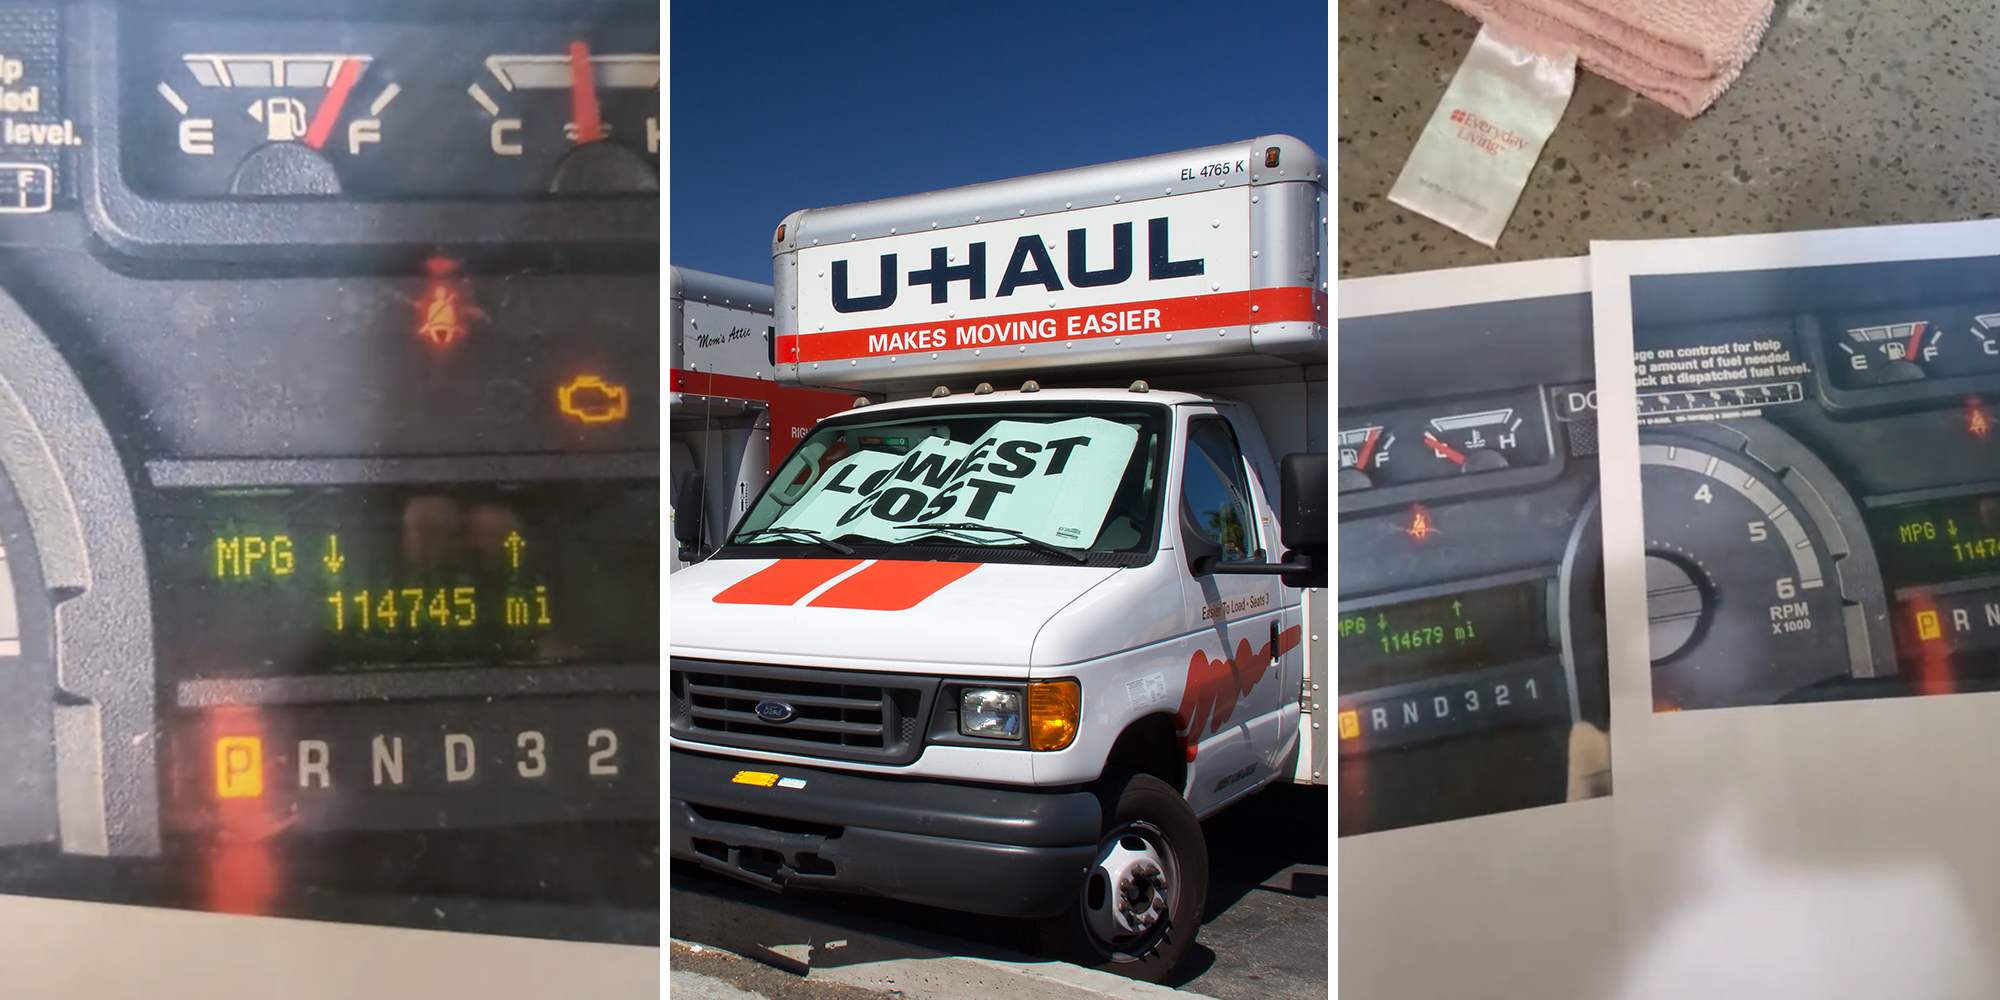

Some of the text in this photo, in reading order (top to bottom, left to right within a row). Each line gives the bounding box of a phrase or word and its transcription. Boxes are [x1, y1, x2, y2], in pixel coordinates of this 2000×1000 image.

[5, 118, 82, 145] level.
[179, 118, 382, 155] E F
[490, 118, 522, 155] C
[1457, 127, 1500, 155] Living
[1463, 113, 1528, 150] Everyday
[17, 170, 35, 183] F
[1181, 160, 1244, 181] EL 4765 K
[831, 216, 1205, 314] U-HAUL
[697, 326, 752, 348] Mom's Attic
[868, 308, 1161, 353] MAKES MOVING EASIER
[1657, 349, 1675, 359] on
[1677, 343, 1730, 357] contract
[1732, 341, 1752, 353] for
[1753, 339, 1782, 352] help
[1851, 346, 1939, 370] E F
[1983, 339, 1999, 355] C
[1649, 360, 1699, 372] amount
[1701, 357, 1715, 369] of
[1716, 355, 1742, 367] fuel
[1744, 351, 1791, 365] needed
[1660, 374, 1674, 385] at
[1677, 367, 1748, 384] dispatched
[1750, 365, 1775, 378] fuel
[1777, 363, 1812, 376] level.
[1499, 433, 1517, 449] H
[821, 436, 1092, 496] LOWEST
[1375, 452, 1390, 468] F
[836, 478, 1016, 527] COST
[1694, 484, 1713, 504] 4
[1747, 521, 1768, 542] 5
[1900, 522, 1936, 543] MPG
[216, 535, 294, 577] MPG
[1776, 577, 1795, 599] 6
[329, 585, 551, 631] 114745 mi
[1201, 605, 1222, 620] Easier
[1222, 602, 1231, 615] To
[1231, 597, 1245, 613] Load
[1249, 595, 1265, 608] Seats
[1770, 602, 1809, 621] RPM
[1919, 613, 1936, 637] P
[1953, 609, 1970, 632] R
[1381, 621, 1475, 653] 114679 mi
[763, 705, 783, 716] Ford
[1340, 678, 1538, 737] P R N D 3 2 1
[224, 729, 618, 790] P R N D 3 2
